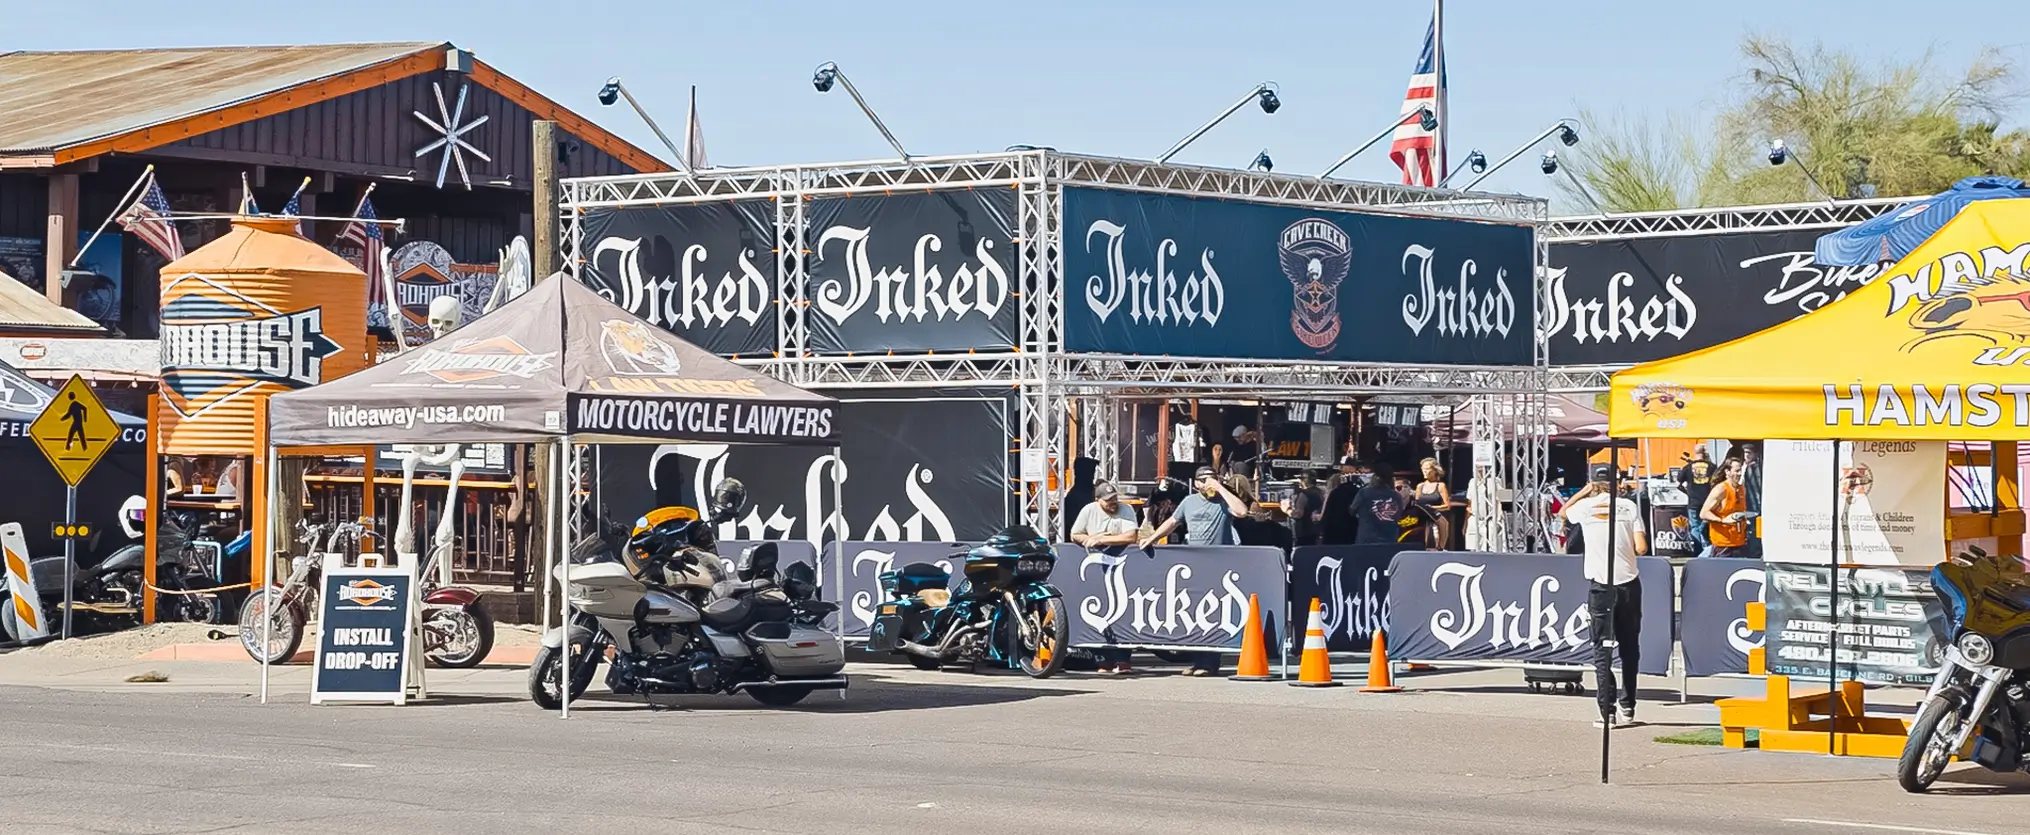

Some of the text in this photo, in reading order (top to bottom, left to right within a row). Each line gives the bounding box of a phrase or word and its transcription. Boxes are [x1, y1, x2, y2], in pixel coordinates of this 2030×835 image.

[1284, 222, 1312, 249] CAVE
[593, 236, 769, 329] Inked
[817, 225, 1008, 326] Inked
[1086, 219, 1224, 328] Inked
[1402, 244, 1515, 340] Inked
[1536, 266, 1697, 345] Inked
[662, 377, 768, 397] TIGERS
[327, 404, 506, 429] hideaway-usa.com
[577, 398, 833, 438] MOTORCYCLE LAWYERS
[1822, 383, 2030, 427] HAMST
[1791, 441, 1917, 457] Hideaay Legends
[1883, 512, 1914, 522] Children
[1892, 523, 1915, 535] money
[1080, 553, 1250, 637] Inked
[1316, 556, 1391, 641] Inke
[1430, 562, 1593, 652] Inke
[333, 628, 394, 646] INSTALL
[1780, 631, 1829, 644] SERVICE
[1843, 634, 1872, 646] FULL
[1786, 620, 1911, 638] AFTERRKET PARTS
[324, 652, 399, 669] DROP-OFF
[1775, 665, 1799, 674] 335
[1878, 672, 1895, 681] RD
[1904, 674, 1934, 683] GILB
